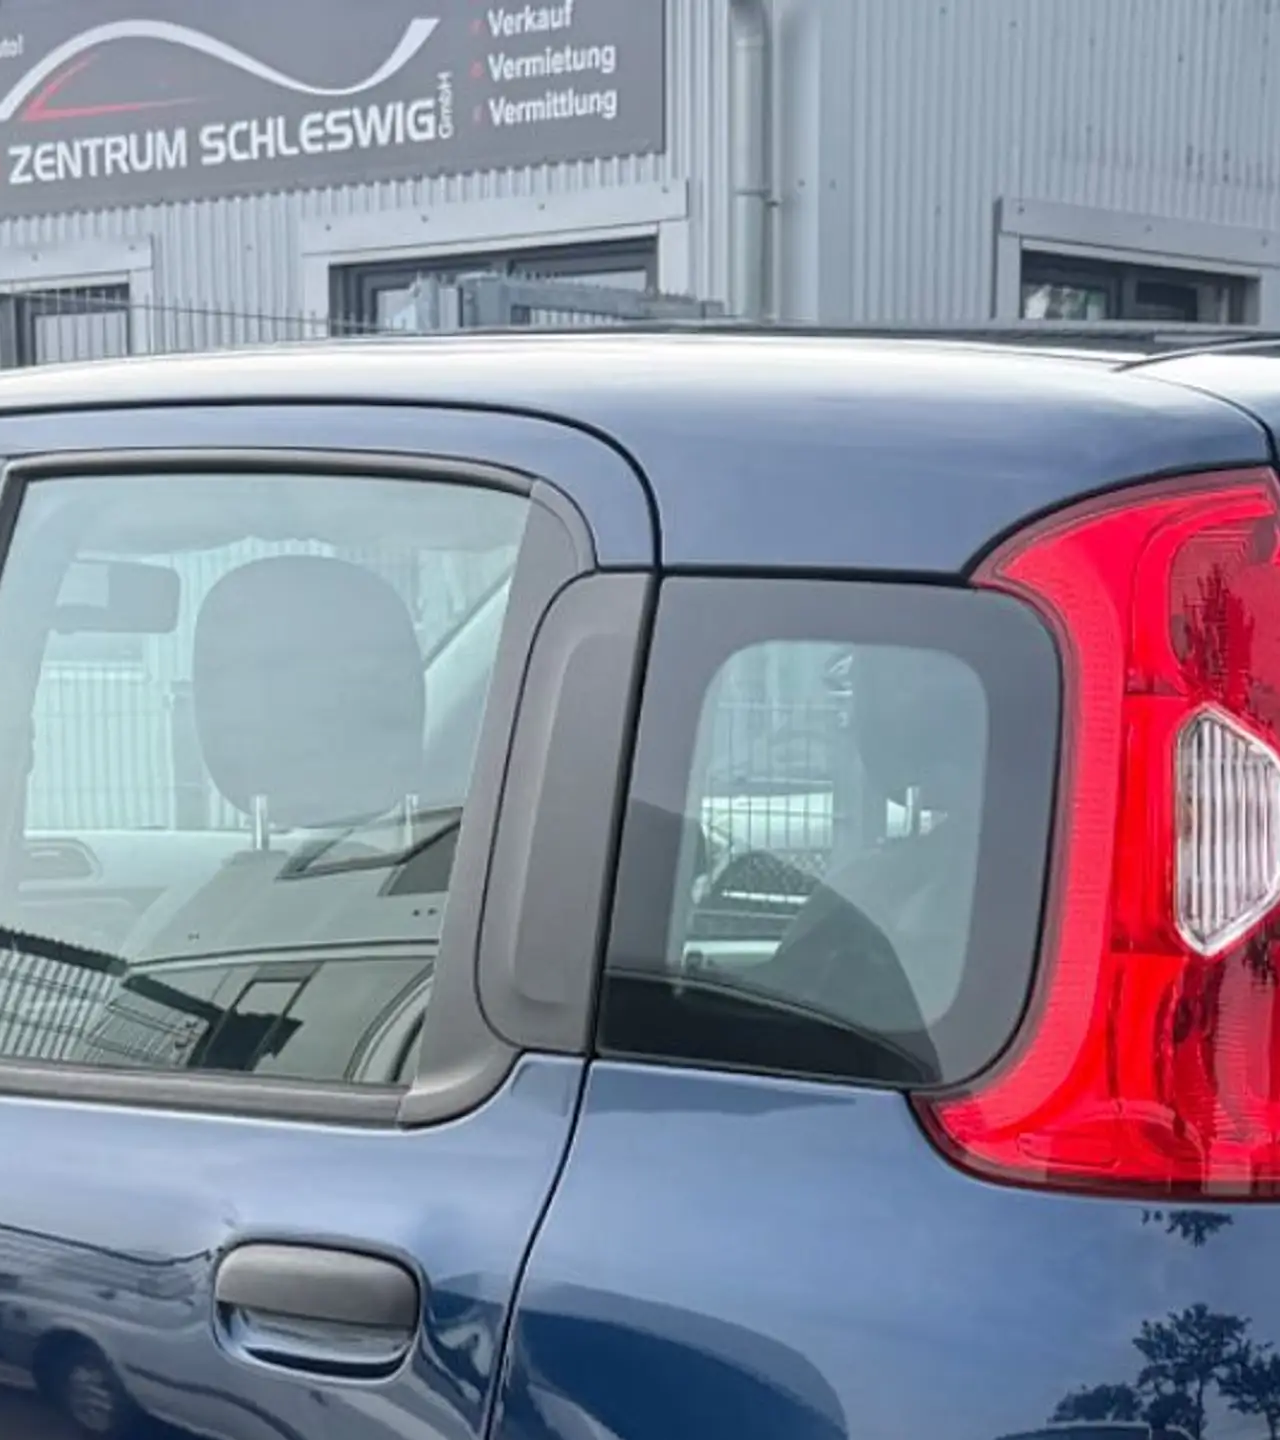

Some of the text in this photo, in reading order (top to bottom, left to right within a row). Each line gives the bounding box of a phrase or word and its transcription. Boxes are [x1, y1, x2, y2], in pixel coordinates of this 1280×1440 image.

[487, 0, 573, 37] Verkauf
[487, 44, 616, 82] Vermietung
[487, 88, 617, 126] Vermittlung
[7, 127, 188, 184] ZENTRUM
[199, 97, 437, 165] SCHLESWIG
